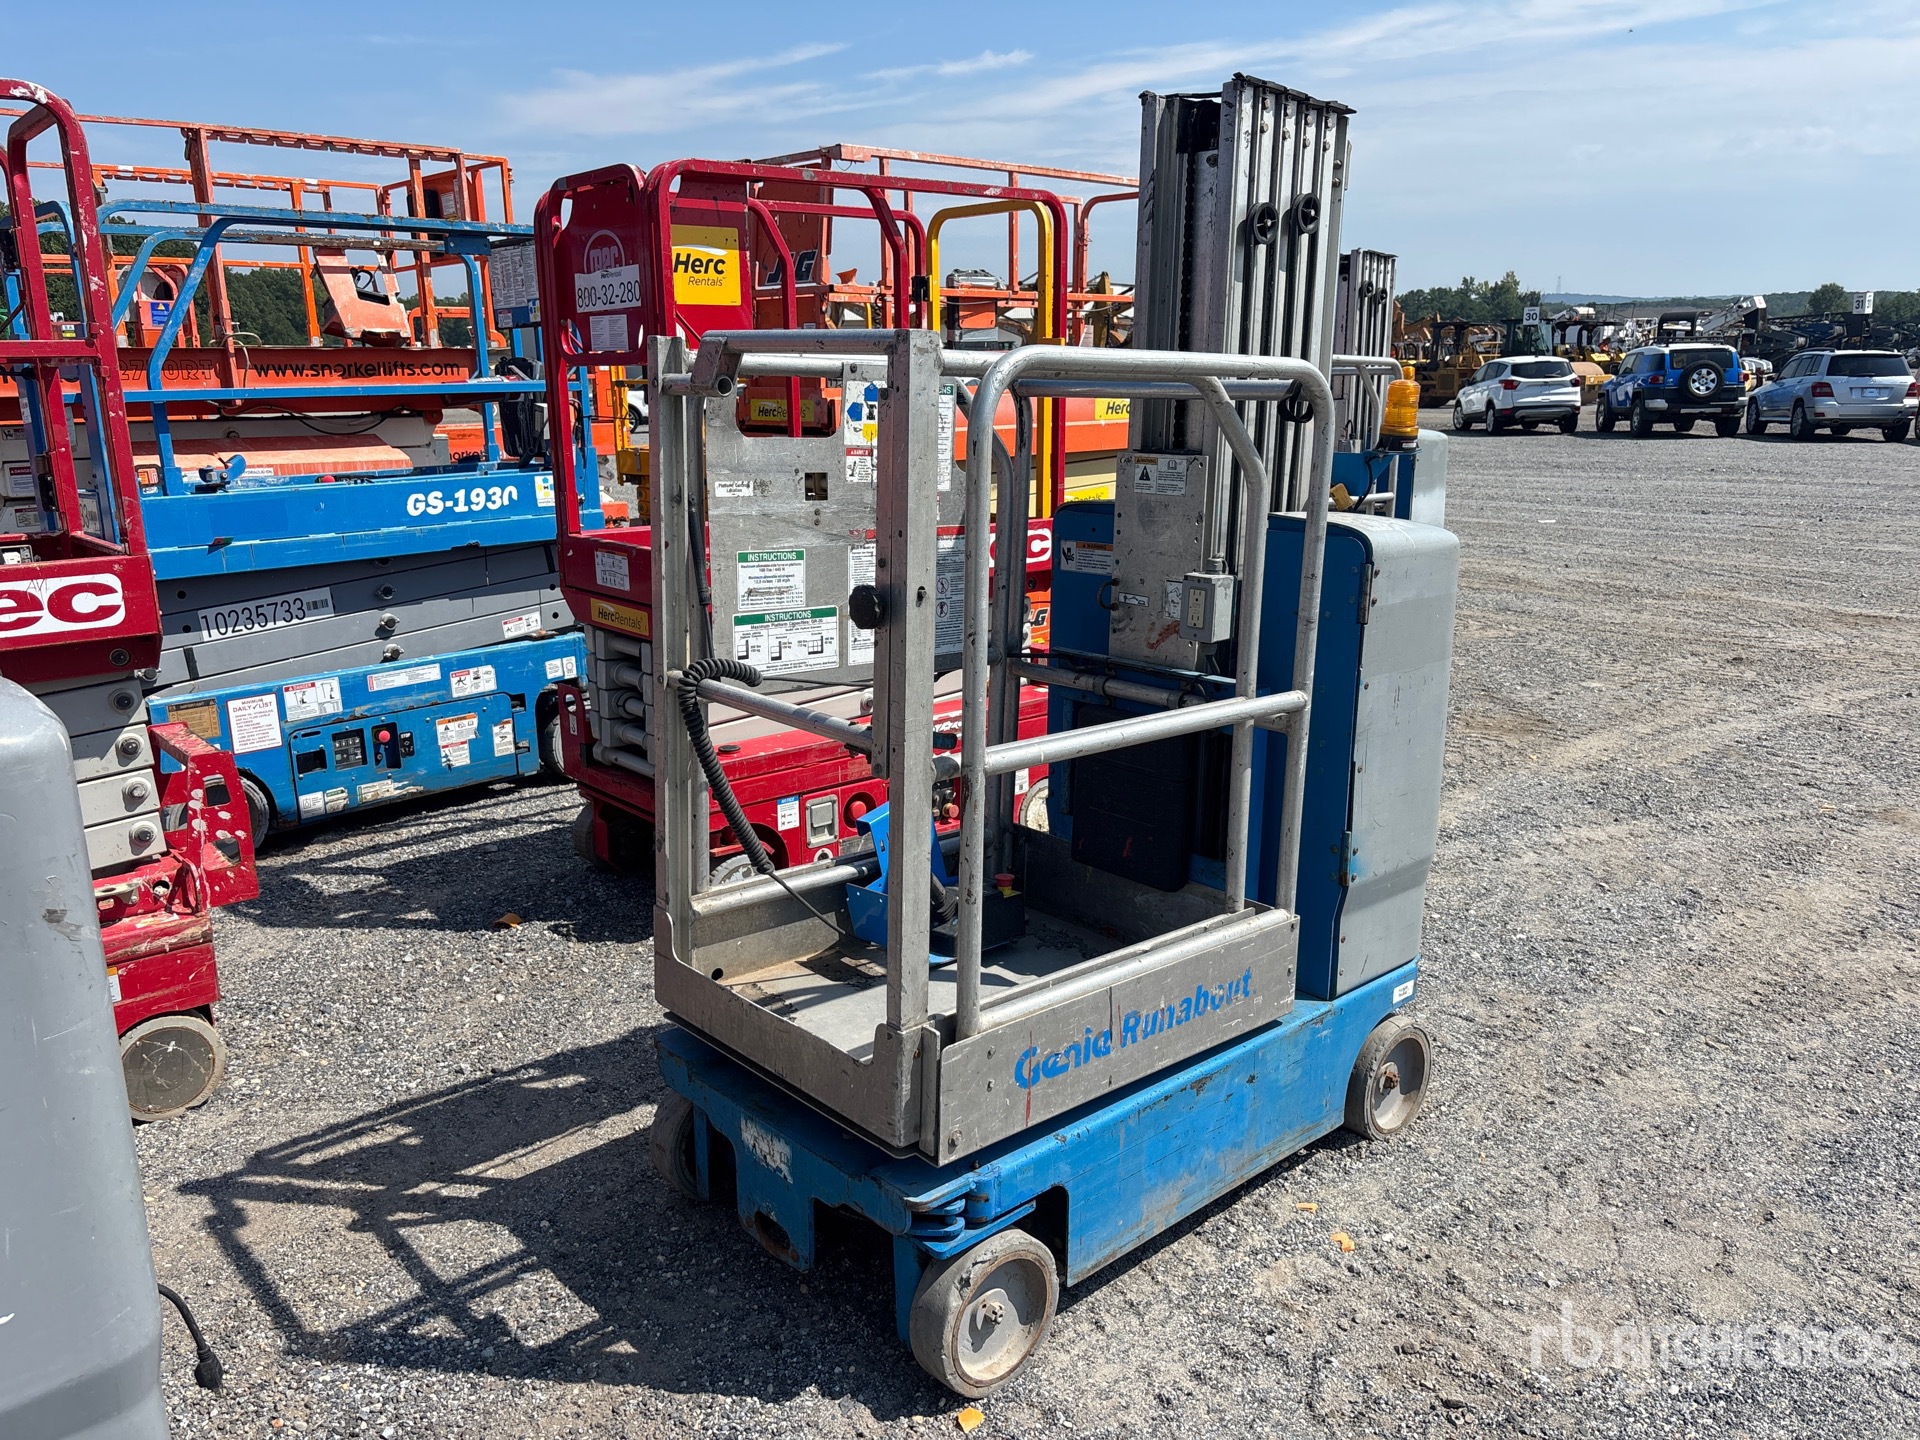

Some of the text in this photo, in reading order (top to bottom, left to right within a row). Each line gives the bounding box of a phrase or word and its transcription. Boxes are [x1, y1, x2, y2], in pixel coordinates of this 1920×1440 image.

[673, 252, 726, 275] Herc
[765, 250, 818, 285] JG
[687, 276, 724, 287] Rentals
[577, 280, 641, 308] 800-32-280
[1855, 300, 1864, 310] 31
[1525, 312, 1538, 321] 30
[118, 359, 213, 381] 270RT
[254, 361, 461, 378] www.snorkellifts.com
[758, 406, 806, 418] HercRels
[406, 485, 518, 517] GS-1930
[747, 552, 797, 562] INSTRUCTIONS
[201, 598, 306, 638] 10235733
[597, 607, 642, 630] HercRentals
[764, 610, 812, 622] INSTRUCTIONS
[233, 701, 273, 713] DAILY LIST
[1120, 966, 1253, 1048] Runabout
[1014, 1026, 1112, 1089] Genie
